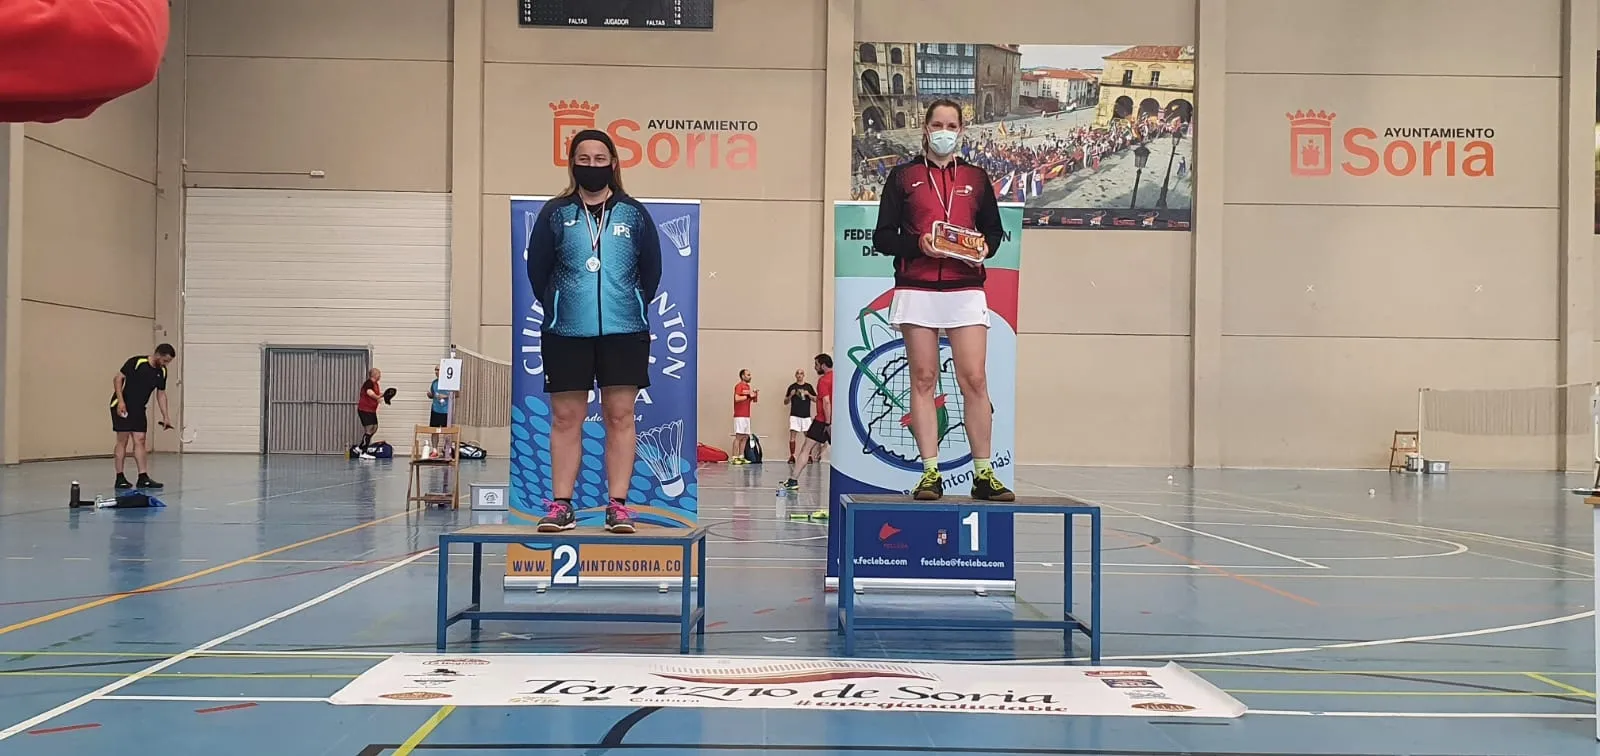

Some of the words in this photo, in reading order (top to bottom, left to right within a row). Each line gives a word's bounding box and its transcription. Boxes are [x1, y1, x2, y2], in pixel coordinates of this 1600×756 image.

[603, 18, 629, 26] JUGADOR
[646, 19, 666, 27] FALTAS
[647, 119, 759, 131] AYUNTAMIENTO
[1384, 127, 1496, 139] AYUNTAMIENTO
[606, 117, 759, 171] Soria
[1340, 127, 1495, 178] Soria
[446, 367, 453, 380] 9
[962, 511, 979, 551] 1
[553, 544, 578, 585] 2
[920, 556, 1005, 569] fecleba@fecleba.com
[518, 679, 799, 702] Torrezno
[813, 683, 880, 699] de
[890, 685, 1060, 704] Soria
